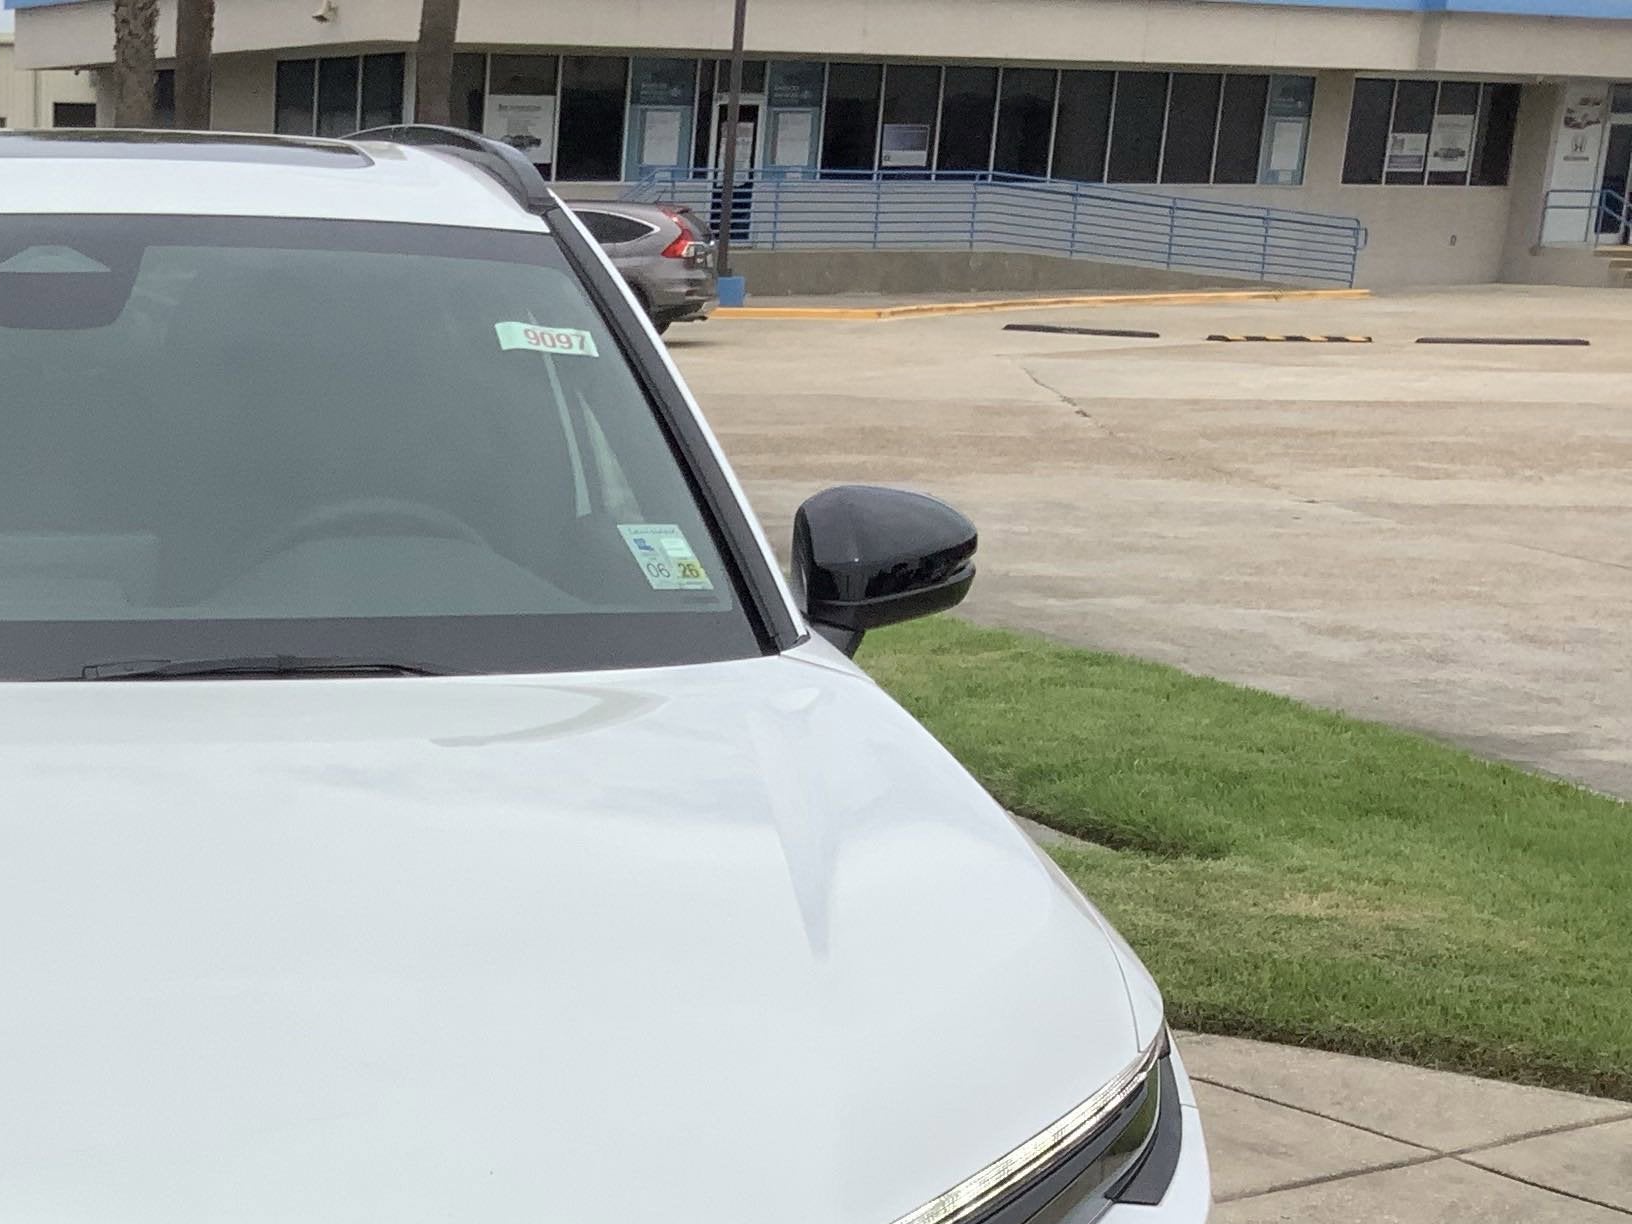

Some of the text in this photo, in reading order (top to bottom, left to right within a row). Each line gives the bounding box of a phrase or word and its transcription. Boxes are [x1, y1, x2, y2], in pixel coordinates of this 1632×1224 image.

[523, 328, 585, 351] 9097
[646, 562, 700, 578] 06 26
